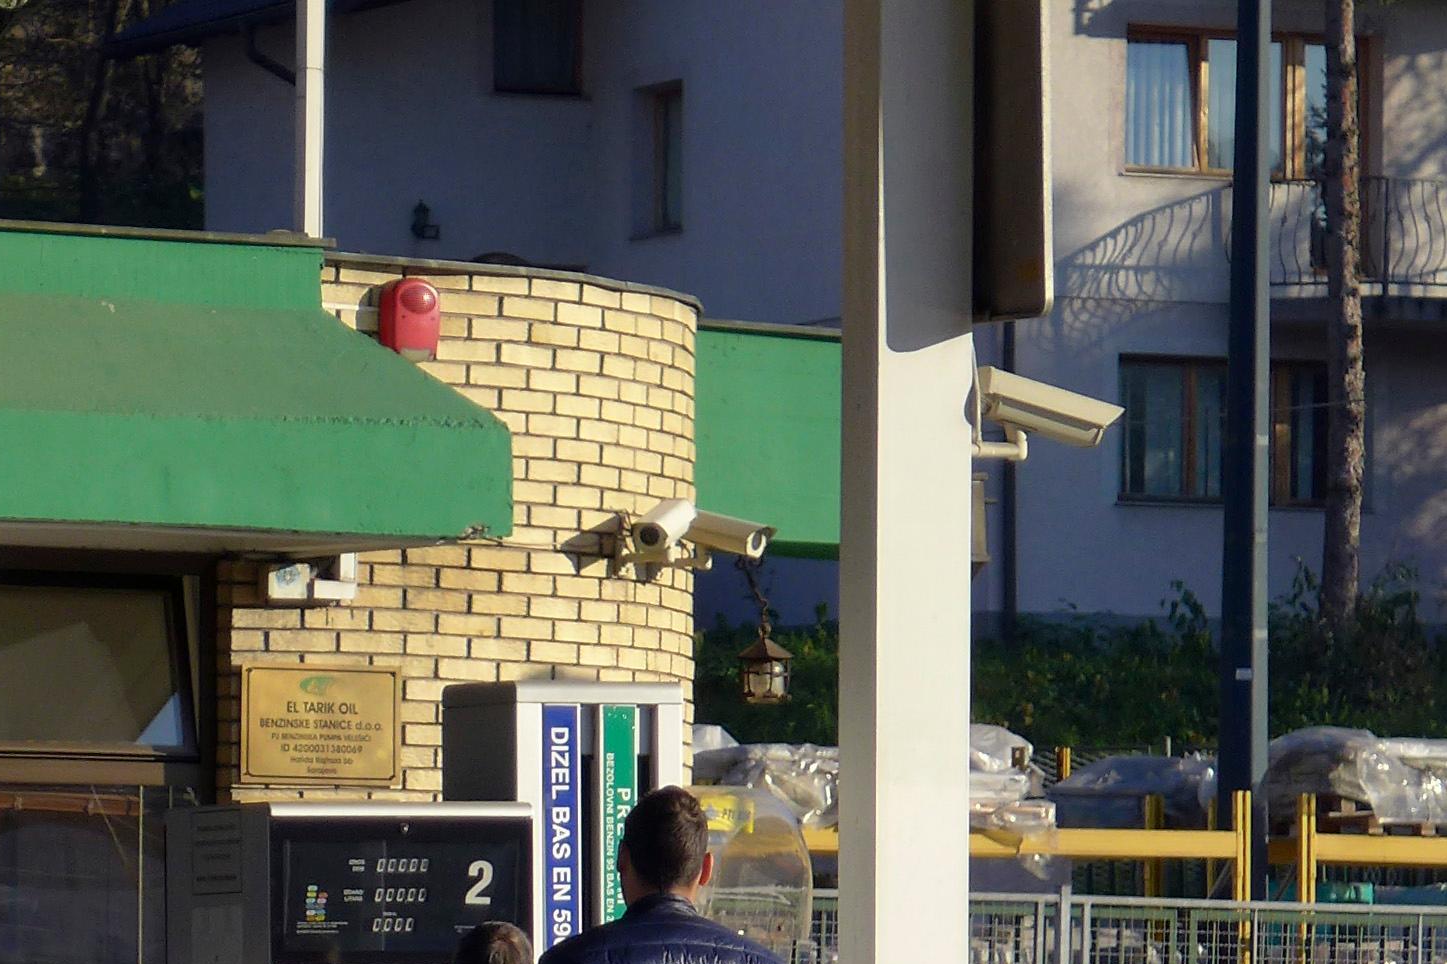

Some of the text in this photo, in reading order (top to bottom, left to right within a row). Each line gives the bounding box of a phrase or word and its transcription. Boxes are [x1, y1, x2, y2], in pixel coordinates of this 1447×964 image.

[259, 717, 310, 730] BENZINSKE
[313, 718, 352, 731] STANICE
[286, 701, 359, 716] EL TARIK OIL
[550, 727, 570, 800] DIZEL
[605, 752, 615, 814] BEZOLOVNI
[551, 806, 571, 860] BAS
[464, 860, 494, 905] 2
[552, 866, 572, 901] EN
